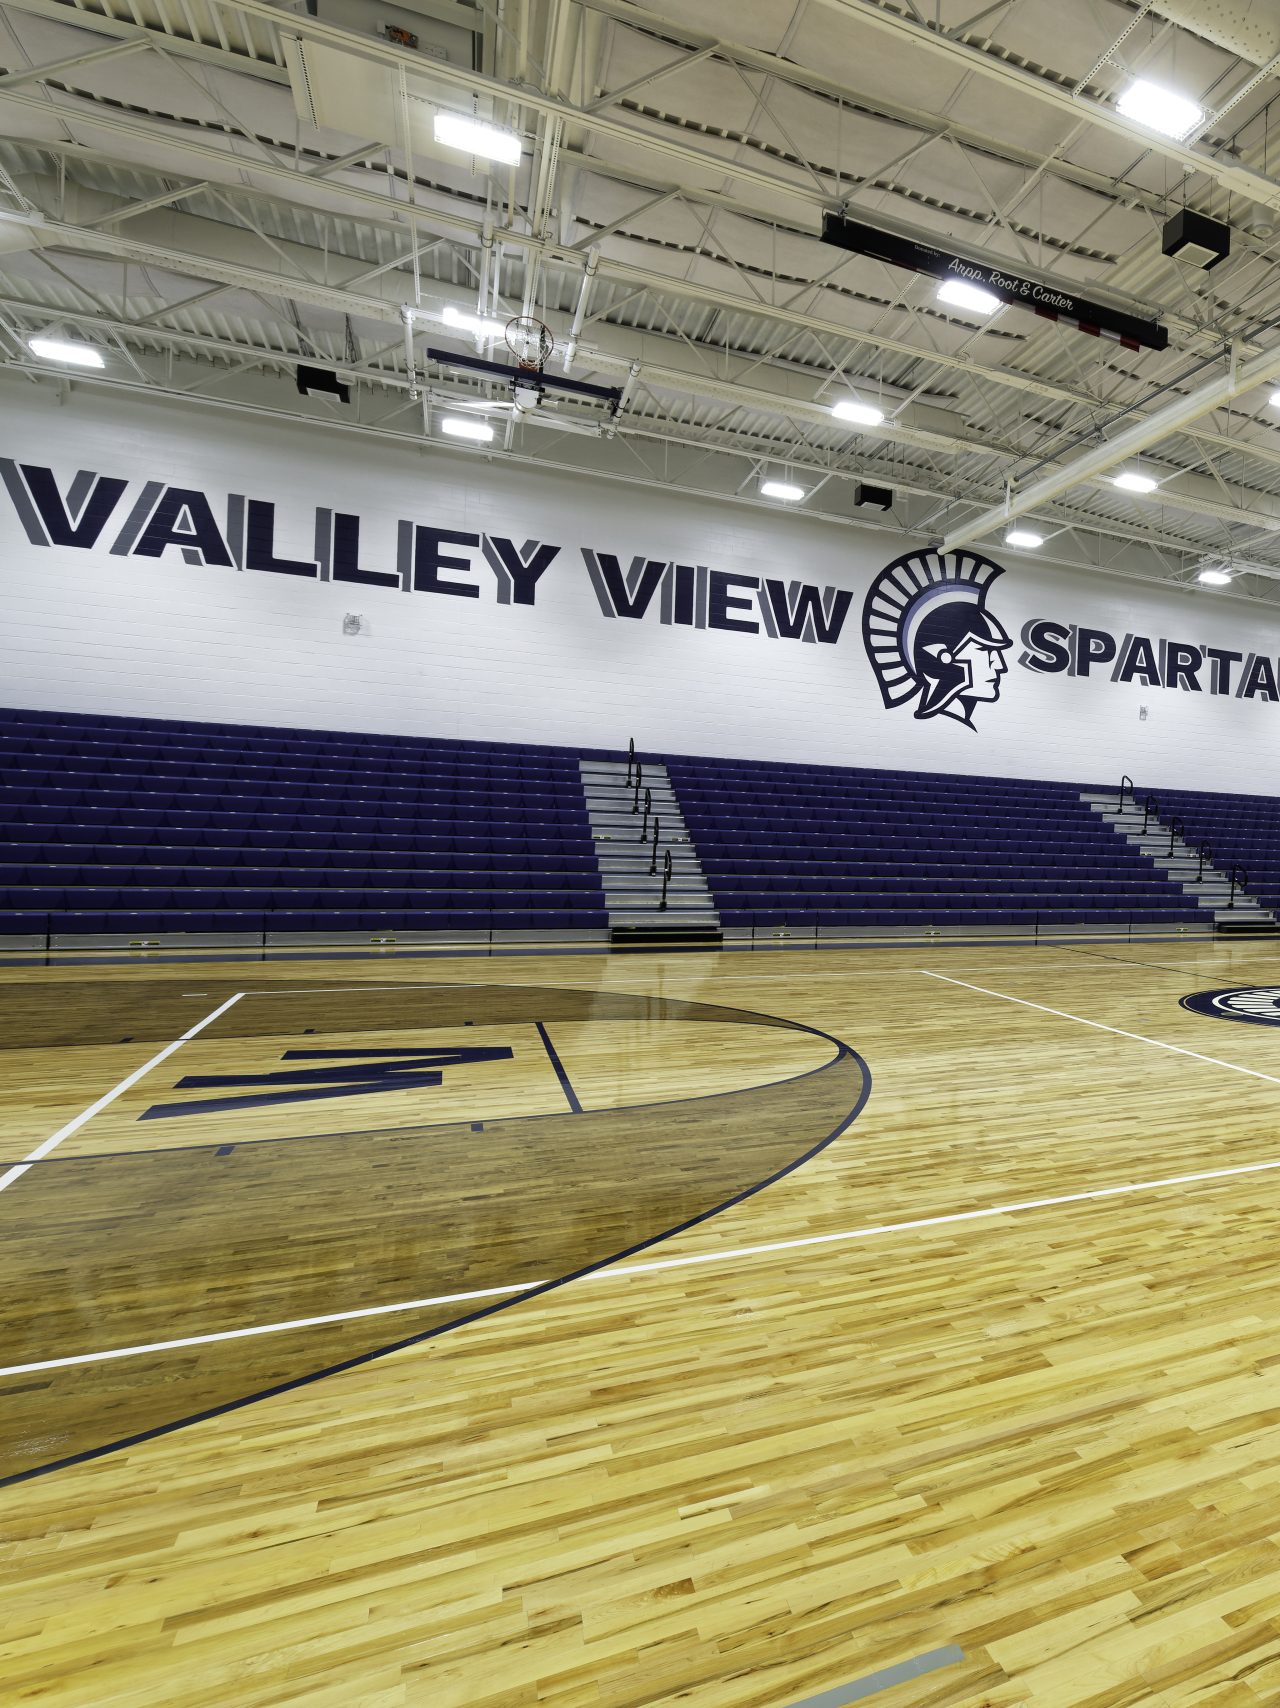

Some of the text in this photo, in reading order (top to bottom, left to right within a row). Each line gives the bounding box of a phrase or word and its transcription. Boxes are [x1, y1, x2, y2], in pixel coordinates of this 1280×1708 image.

[989, 271, 1018, 292] Root
[1020, 282, 1030, 296] &
[1032, 286, 1074, 310] Carter
[0, 457, 853, 644] VALLEY VIEW
